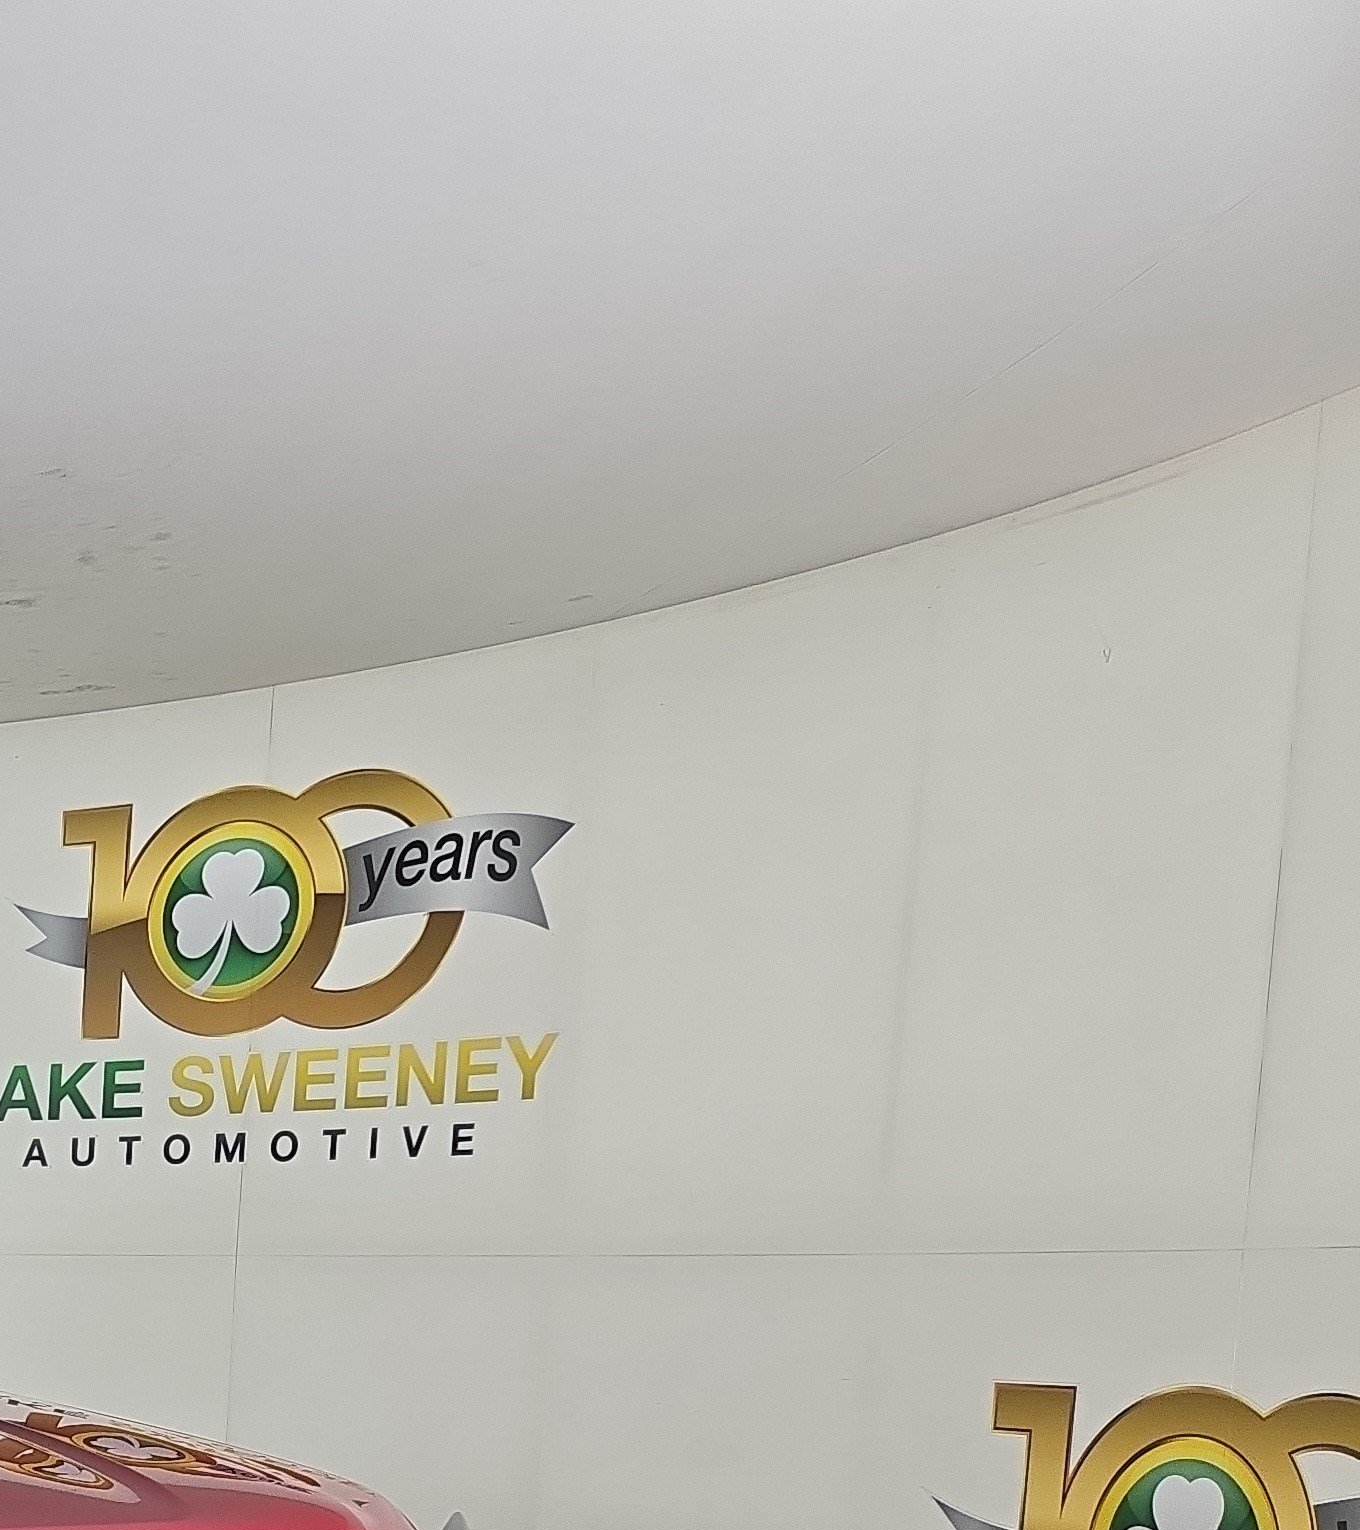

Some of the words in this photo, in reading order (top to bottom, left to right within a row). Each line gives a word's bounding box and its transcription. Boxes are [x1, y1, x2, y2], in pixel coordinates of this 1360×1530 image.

[63, 768, 468, 1040] 100
[360, 827, 521, 911] years
[168, 1032, 559, 1118] SWEENEY
[22, 1122, 476, 1169] AUTOMOTIVE
